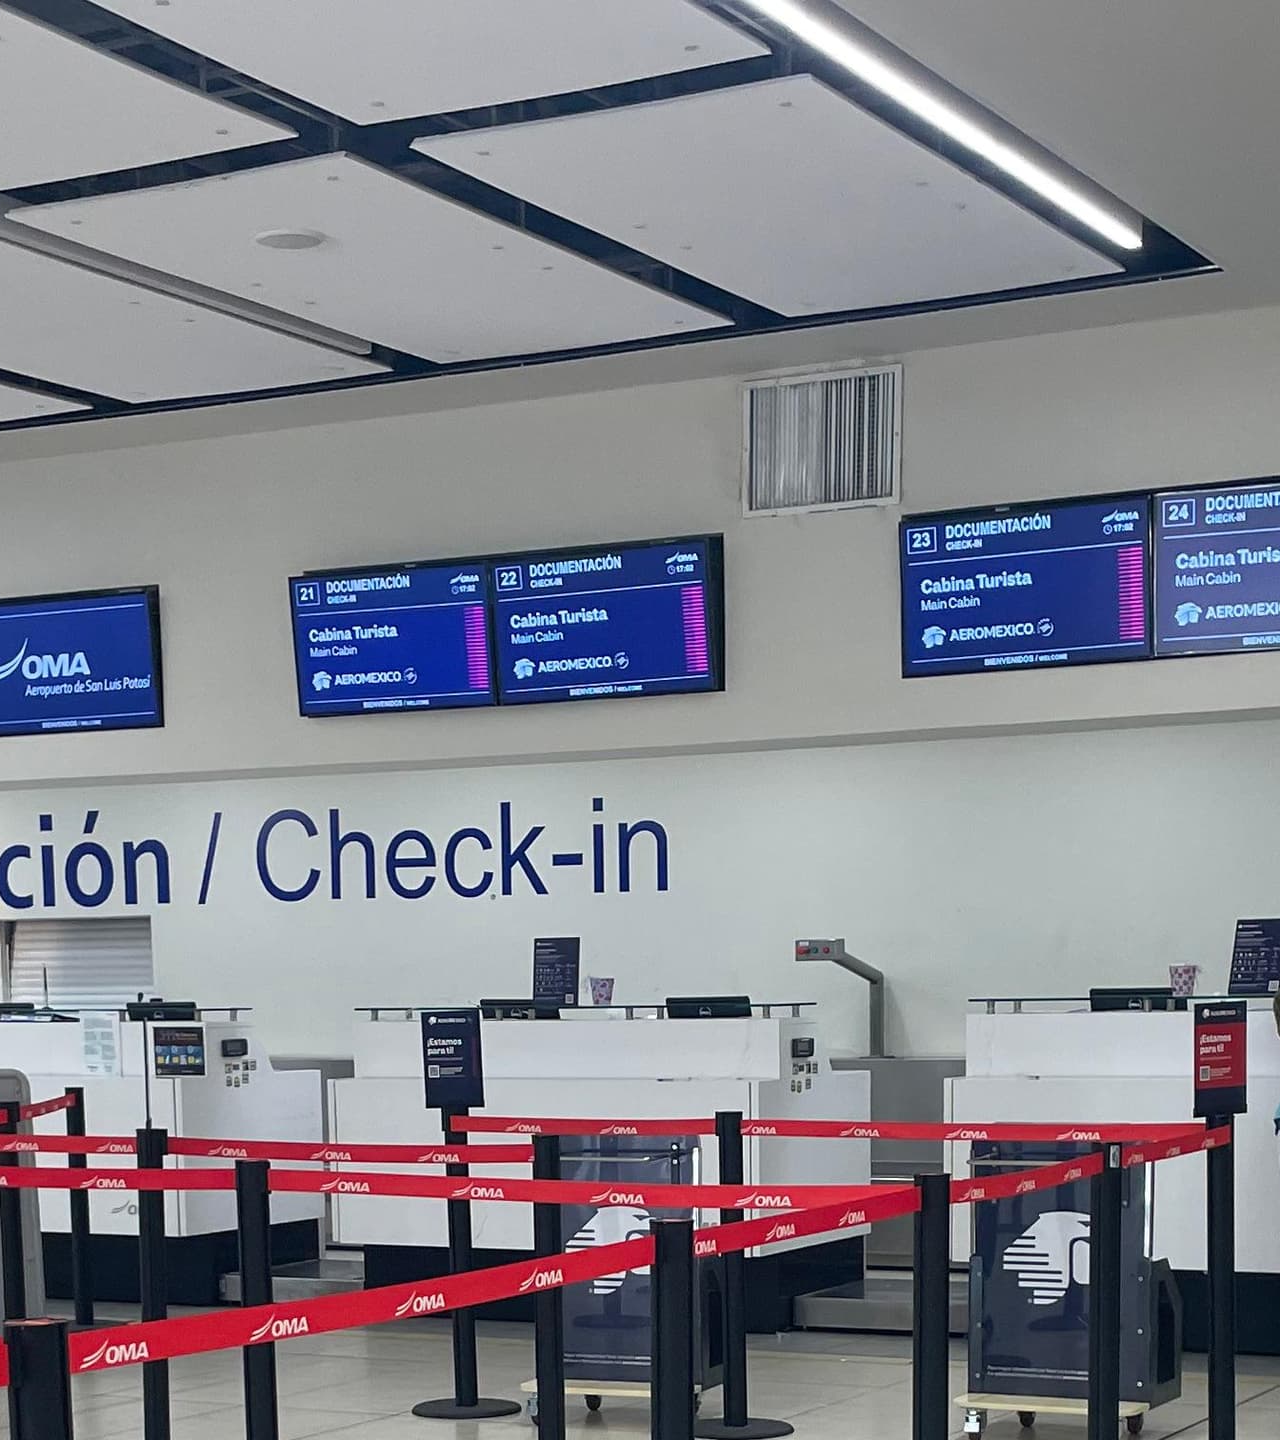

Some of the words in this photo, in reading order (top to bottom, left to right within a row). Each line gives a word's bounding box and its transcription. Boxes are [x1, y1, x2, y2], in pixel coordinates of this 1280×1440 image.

[1169, 505, 1188, 520] 24
[1206, 513, 1245, 524] CHECK-IN
[946, 514, 1051, 538] DOCUMENTACIÓN
[912, 533, 930, 547] 23
[946, 539, 982, 551] CHECK-IN
[530, 554, 621, 577] DOCUMENTACIÓN
[1176, 551, 1235, 570] Cabina
[326, 573, 409, 593] DOCUMENTACIÓN
[501, 572, 517, 585] 22
[921, 577, 974, 594] Cabina
[976, 571, 1032, 589] Turista
[1176, 575, 1204, 587] Main
[1207, 571, 1241, 585] Cabin
[300, 588, 314, 600] 21
[921, 600, 947, 611] Main
[949, 595, 980, 609] Cabin
[511, 613, 557, 628] Cabina
[558, 608, 608, 624] Turista
[309, 627, 352, 642] Cabina
[352, 624, 398, 638] Turista
[511, 634, 534, 644] Main
[535, 630, 563, 642] Cabin
[950, 623, 1035, 641] AEROMEXICO
[310, 647, 331, 657] Main
[332, 645, 357, 656] Cabin
[22, 652, 90, 680] OMA
[538, 656, 612, 673] AEROMEXICO
[335, 671, 402, 685] AEROMEXICO
[25, 683, 72, 699] Aeropuerto
[74, 681, 84, 693] de
[85, 679, 102, 692] San
[104, 678, 121, 691] Luis
[123, 674, 150, 689] Potosí
[256, 797, 667, 901] Check-in
[613, 1126, 637, 1135] OMA
[854, 1127, 880, 1138] OMA
[1072, 1131, 1101, 1141] OMA
[96, 1177, 126, 1189] OMA
[337, 1181, 370, 1193] OMA
[471, 1187, 505, 1199] OMA
[609, 1193, 645, 1205] OMA
[755, 1195, 792, 1207] OMA
[776, 1223, 796, 1238] OMA
[695, 1240, 717, 1254] OMA
[535, 1269, 563, 1288] OMA
[413, 1293, 445, 1313] OMA
[272, 1315, 309, 1337] OMA
[105, 1341, 149, 1364] OMA
